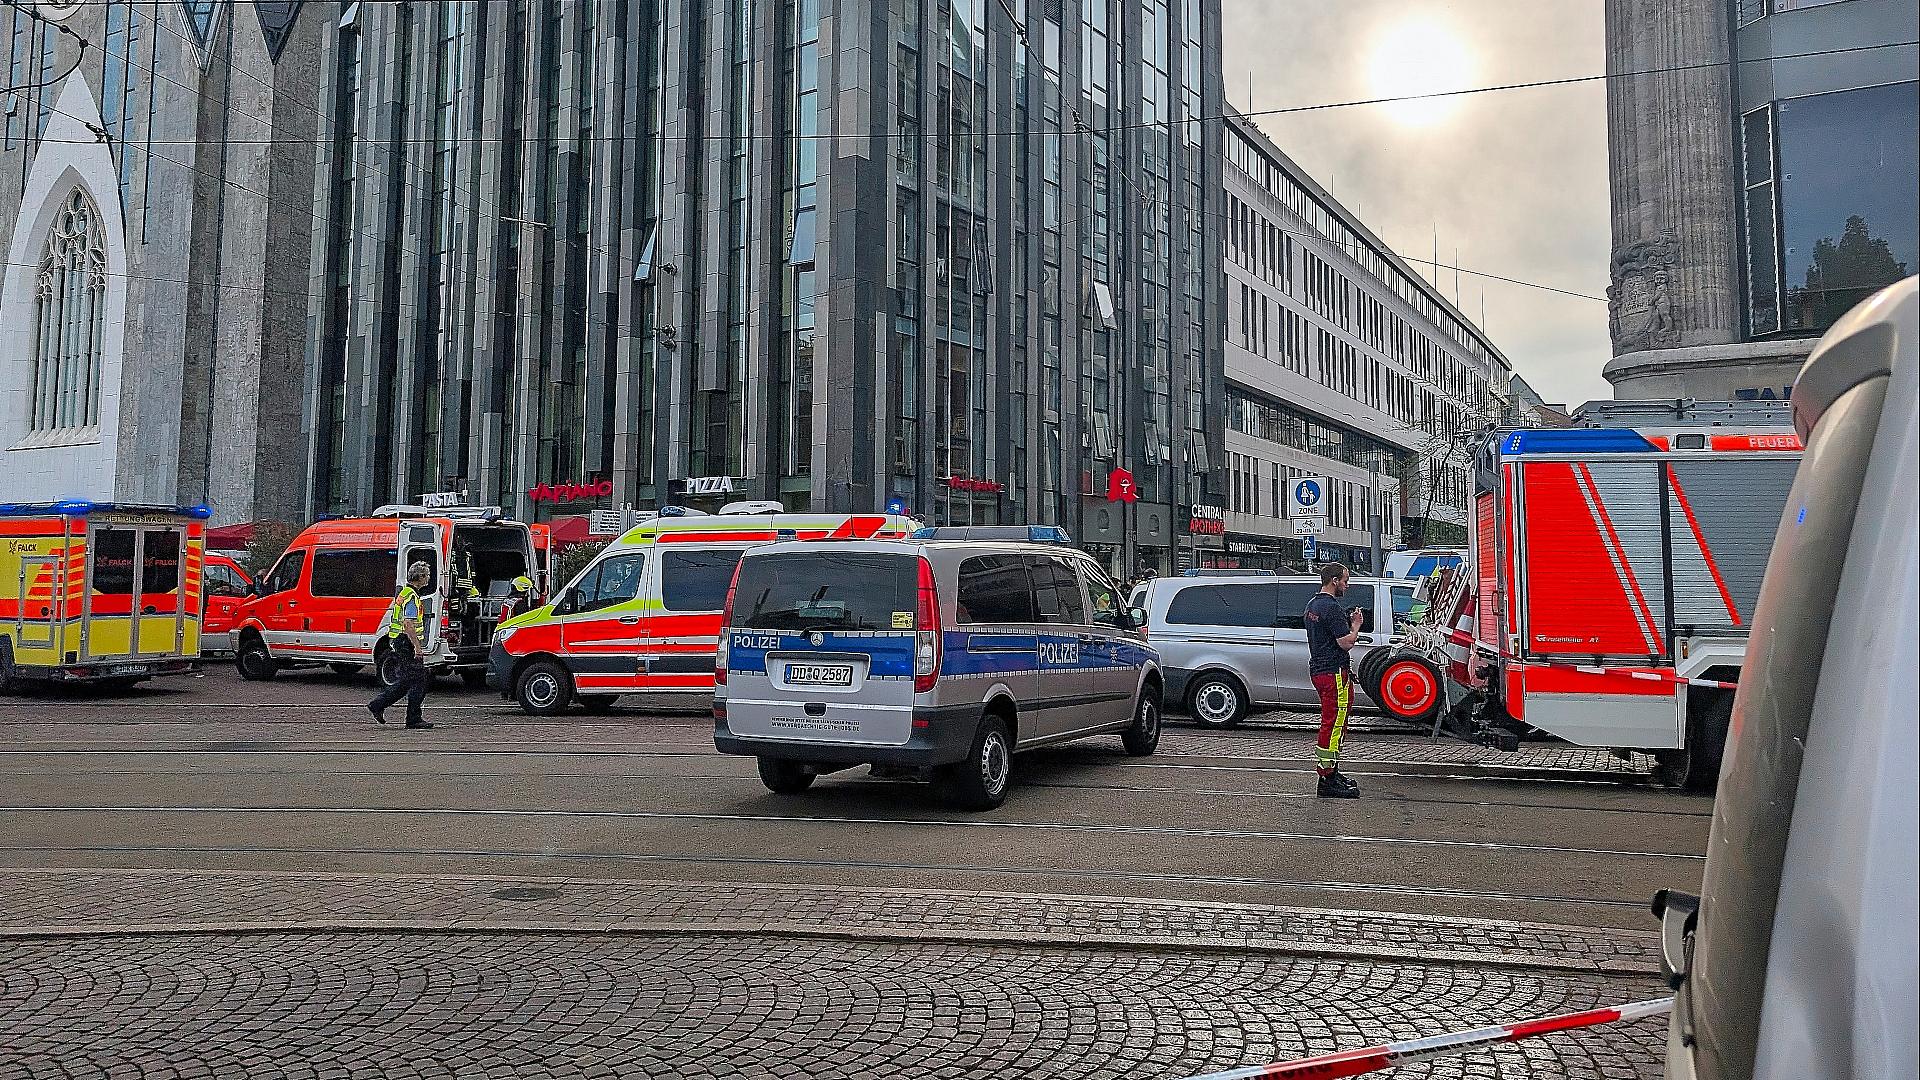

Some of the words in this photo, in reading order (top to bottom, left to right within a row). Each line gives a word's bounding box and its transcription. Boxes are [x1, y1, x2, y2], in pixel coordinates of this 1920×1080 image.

[1748, 437, 1803, 448] FEUER
[686, 476, 734, 494] PIZZA
[422, 492, 459, 507] PASTA
[1191, 503, 1223, 520] CENTRAL
[1298, 506, 1319, 515] ZONE
[1190, 518, 1225, 535] APOTHEKE
[17, 543, 37, 552] FALCK
[733, 635, 781, 649] POLIZEI
[1039, 642, 1080, 664] POLIZEI
[791, 667, 806, 680] DD
[821, 667, 850, 681] 2587
